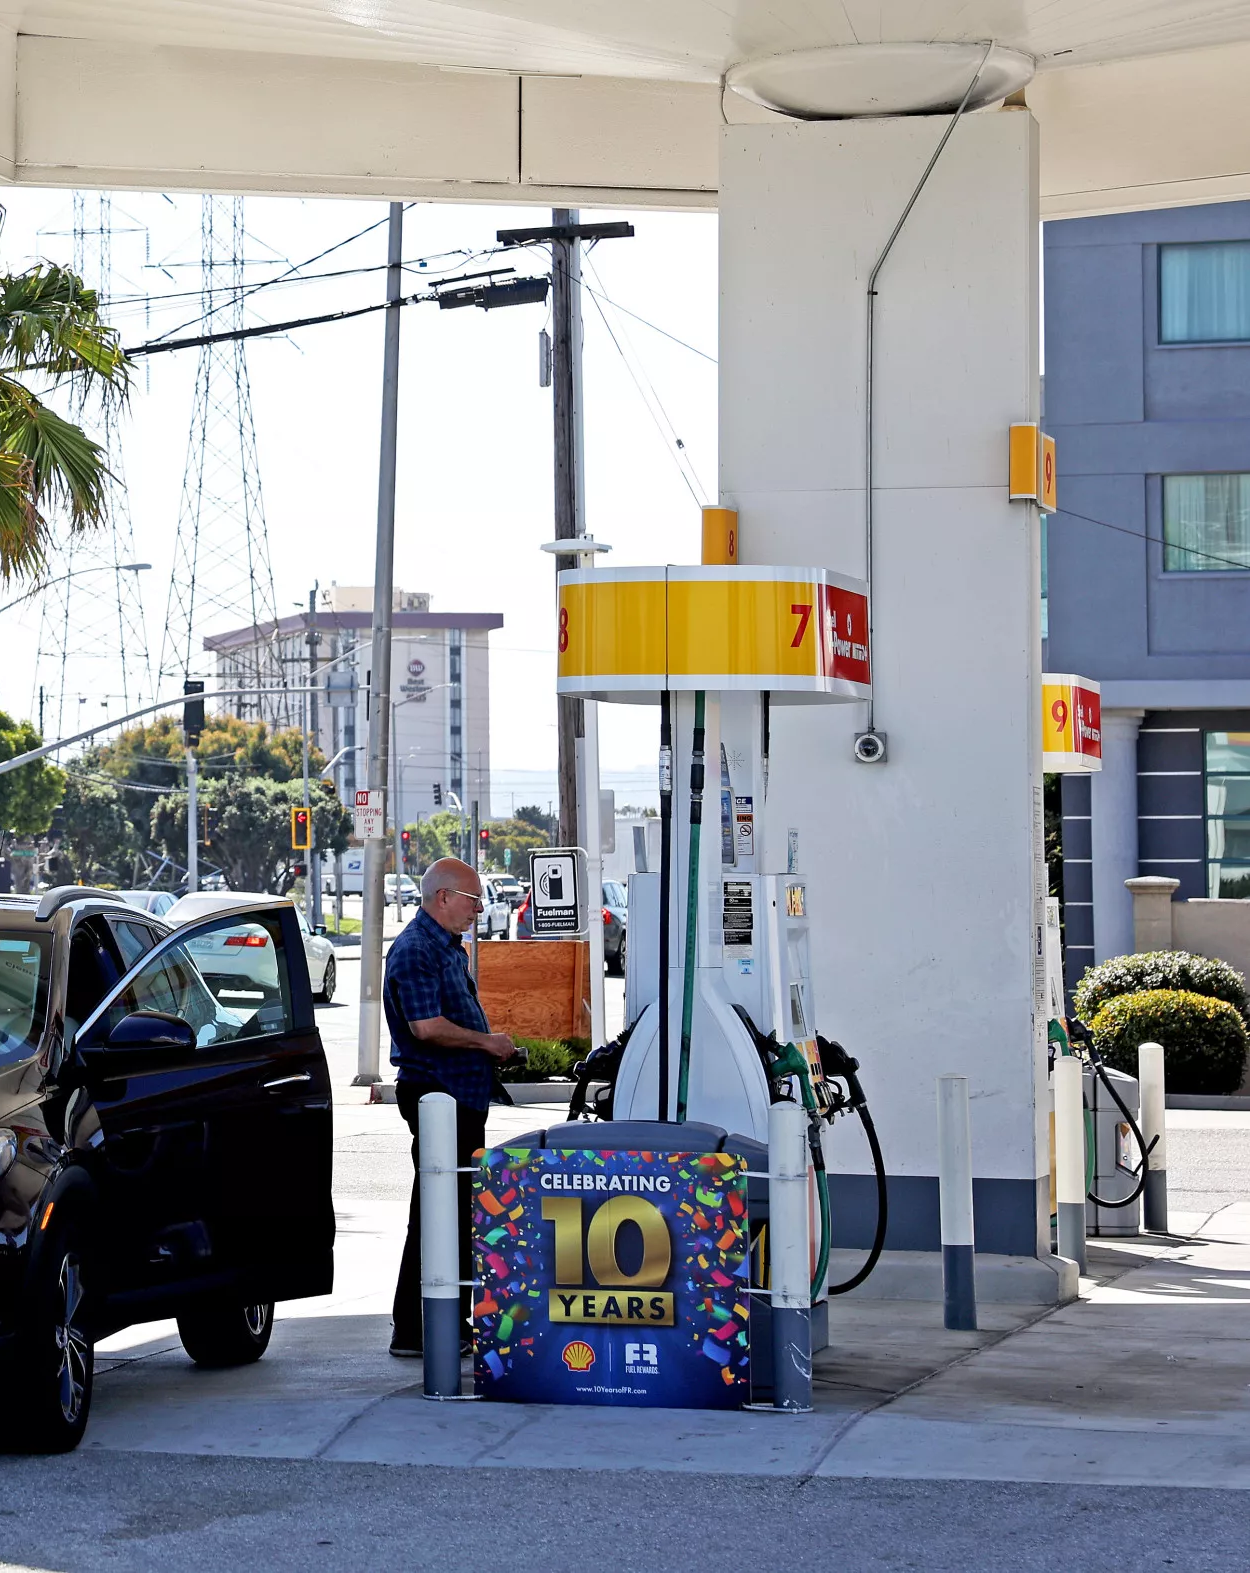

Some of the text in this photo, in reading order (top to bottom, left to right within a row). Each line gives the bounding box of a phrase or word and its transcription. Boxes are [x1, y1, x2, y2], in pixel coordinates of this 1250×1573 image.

[1045, 452, 1052, 494] 9
[728, 530, 735, 557] 8
[559, 607, 569, 653] 8
[790, 604, 813, 648] 7
[1051, 699, 1068, 733] 9
[357, 792, 367, 805] NO
[356, 808, 383, 817] STOPPING
[363, 826, 375, 834] TIME
[537, 908, 574, 916] Fuelman
[540, 1173, 672, 1192] CELEBRATING
[541, 1195, 671, 1287] 10
[557, 1294, 665, 1320] YEARS
[625, 1343, 658, 1365] FR
[625, 1365, 658, 1374] FUEL REWARDS
[576, 1385, 647, 1395] www.10YearsofFR.com
